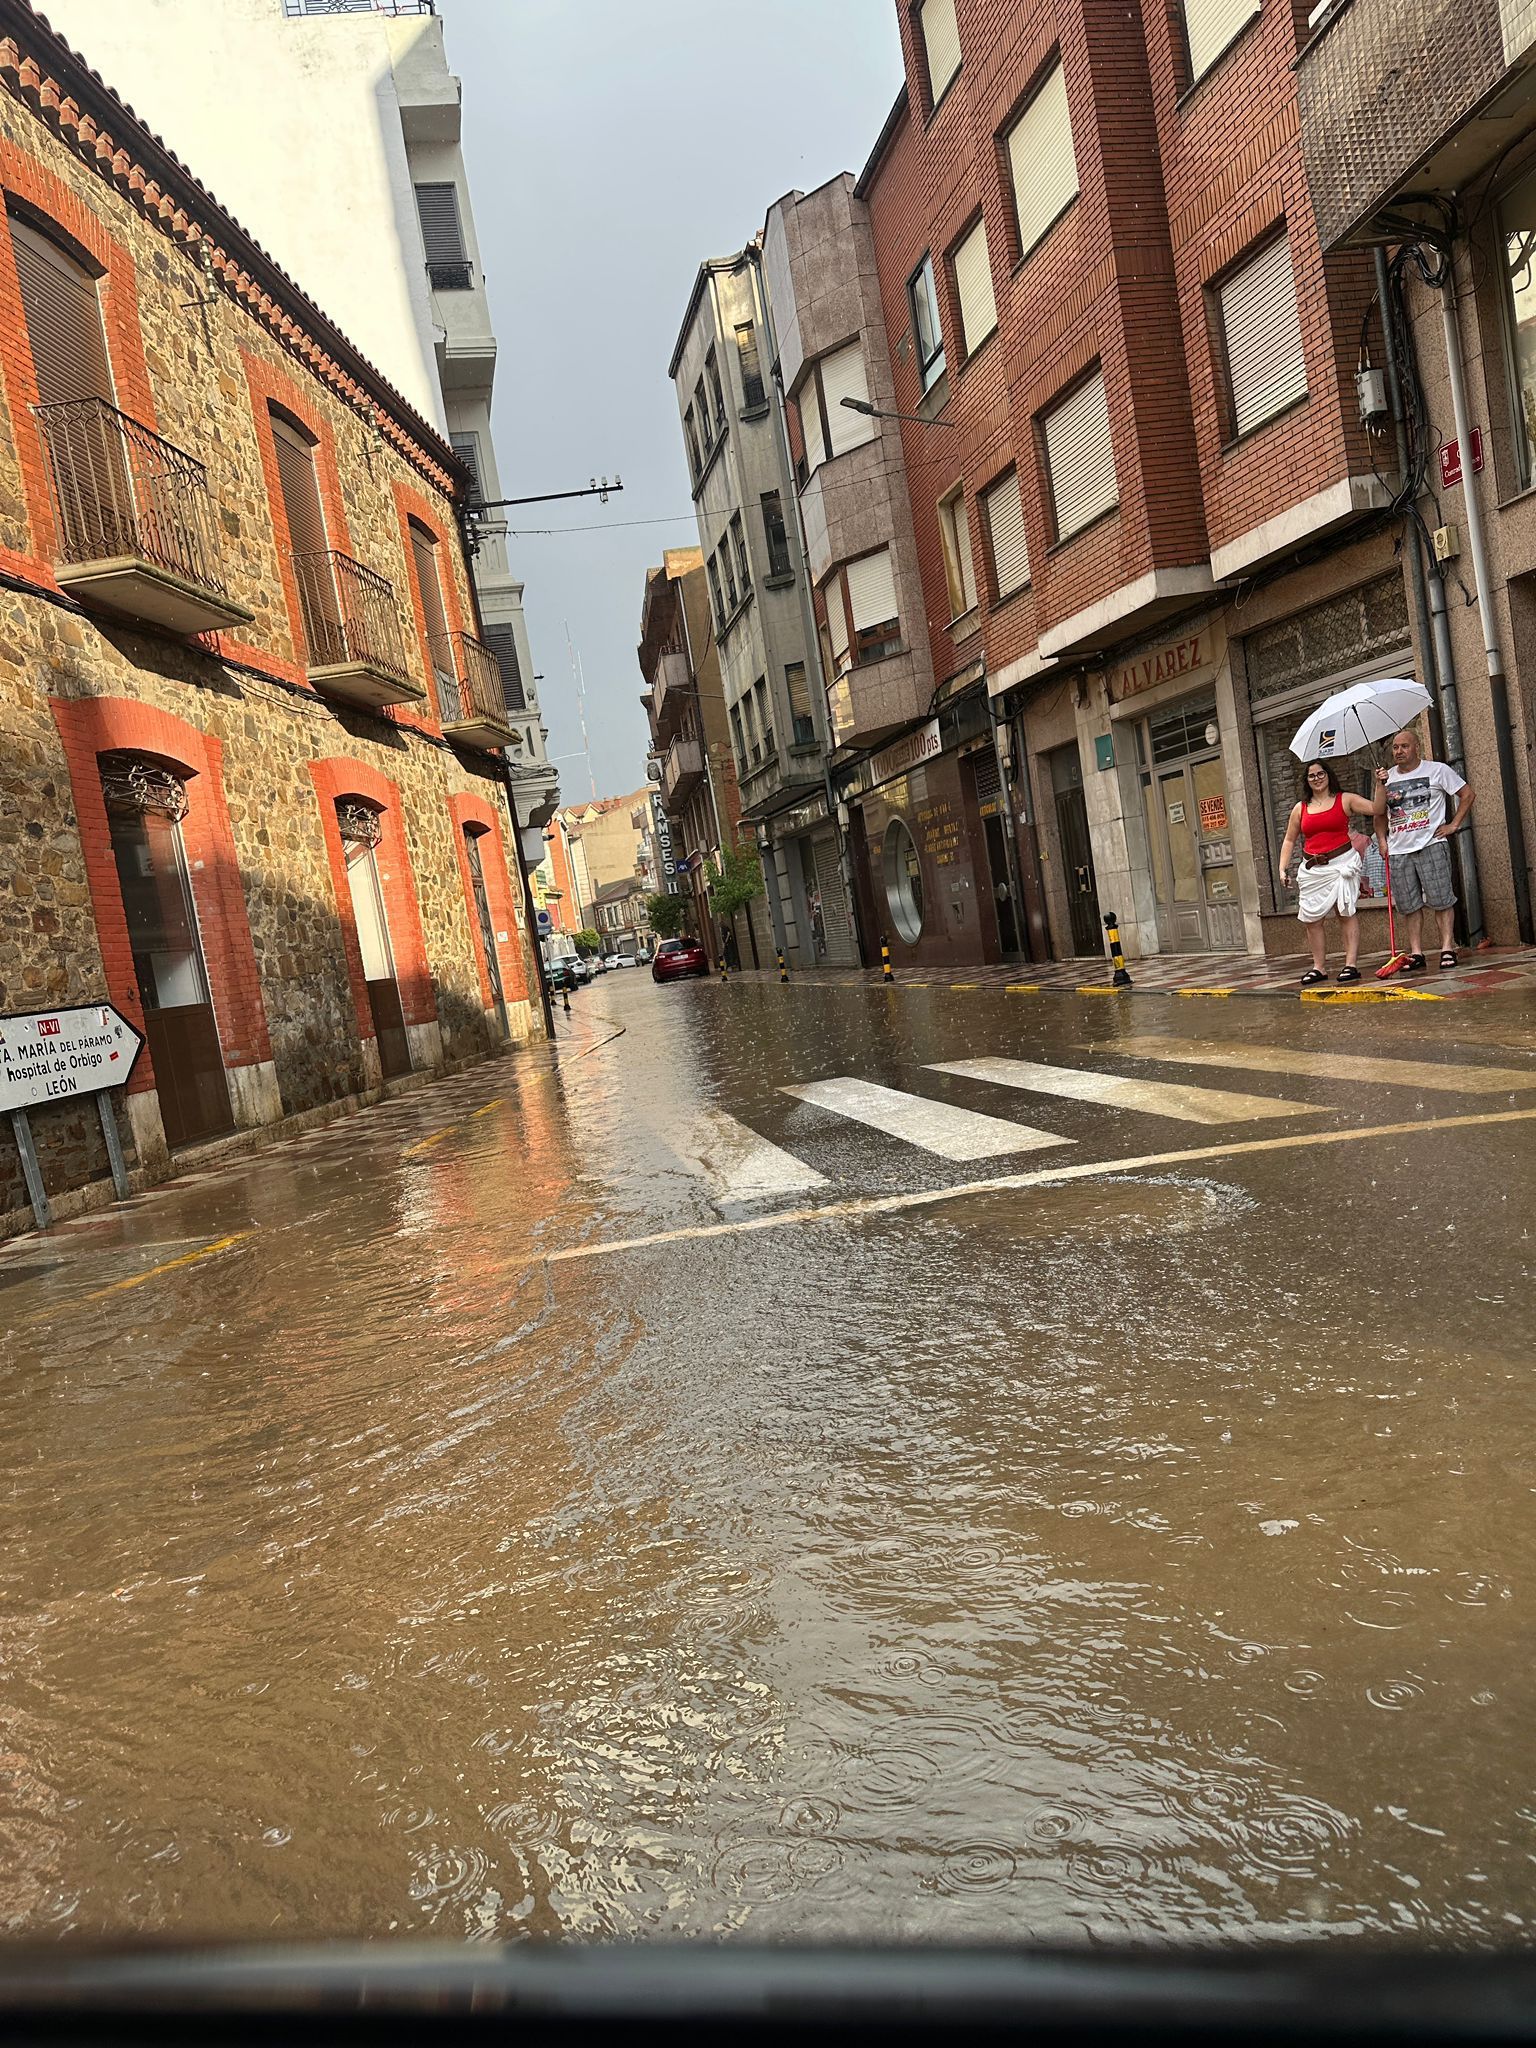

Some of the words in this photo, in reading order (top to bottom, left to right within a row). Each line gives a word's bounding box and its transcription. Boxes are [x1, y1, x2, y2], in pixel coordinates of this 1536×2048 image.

[1123, 637, 1201, 698] ALVAREZ
[910, 733, 926, 761] 100
[1200, 802, 1207, 814] SE
[1208, 798, 1224, 812] VENDE
[653, 794, 675, 875] RAMSES
[667, 881, 679, 895] II
[39, 1020, 59, 1034] N-VI
[18, 1038, 57, 1060] MARÍA
[60, 1040, 77, 1053] DEL
[79, 1035, 113, 1049] PÁRAMO
[7, 1063, 51, 1082] hospital
[54, 1059, 66, 1072] de
[69, 1052, 103, 1069] Orbigo
[46, 1075, 77, 1096] LEÓN
